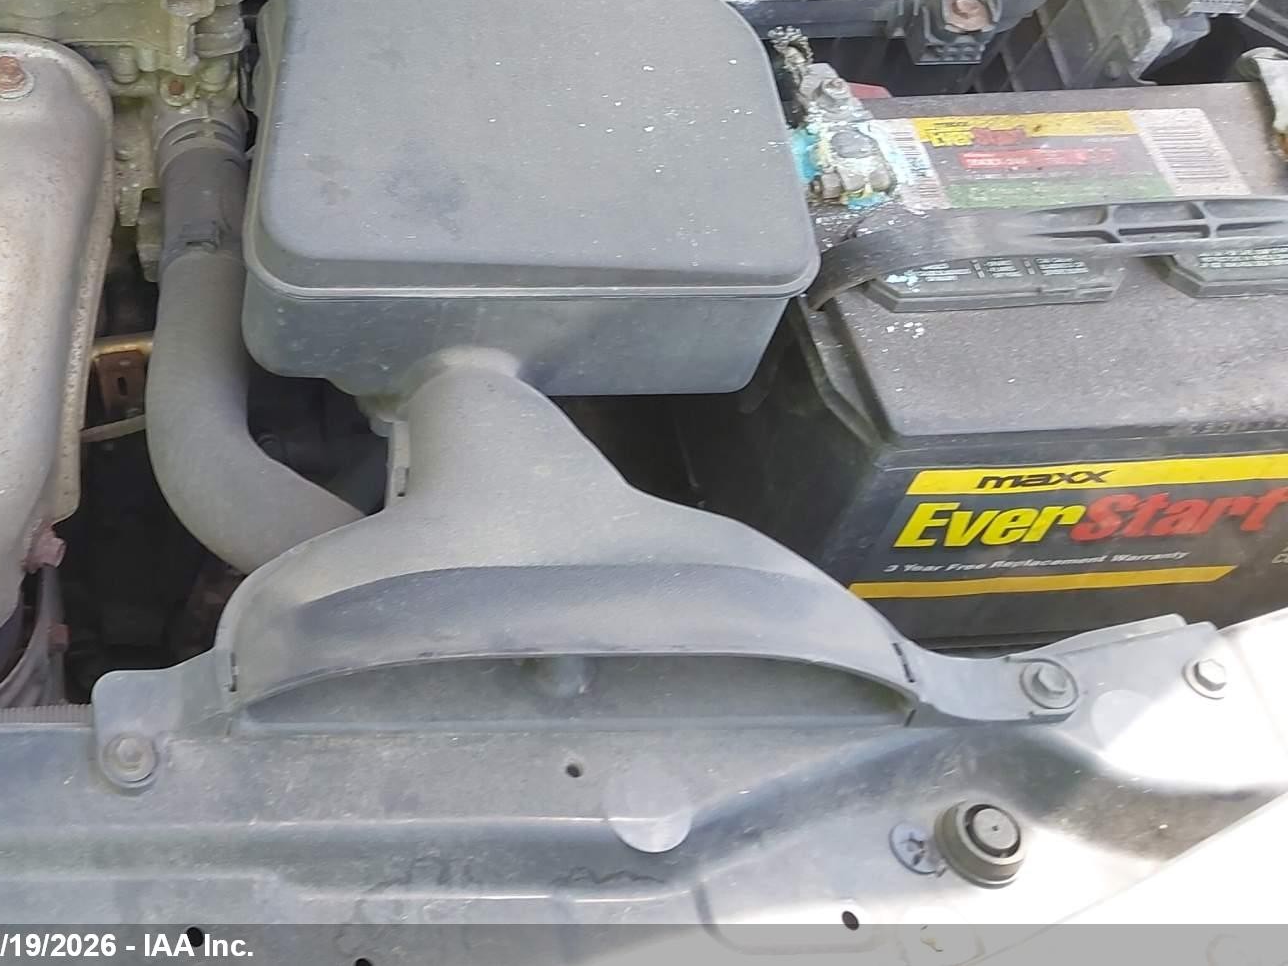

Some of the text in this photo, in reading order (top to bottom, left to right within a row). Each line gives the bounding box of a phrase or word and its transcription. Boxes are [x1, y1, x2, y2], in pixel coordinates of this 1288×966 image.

[977, 470, 1114, 489] maxx
[893, 487, 1288, 548] EverStart
[903, 562, 944, 572] Year
[945, 562, 988, 572] Free
[989, 556, 1108, 569] Replacement
[1110, 551, 1191, 562] Warranty
